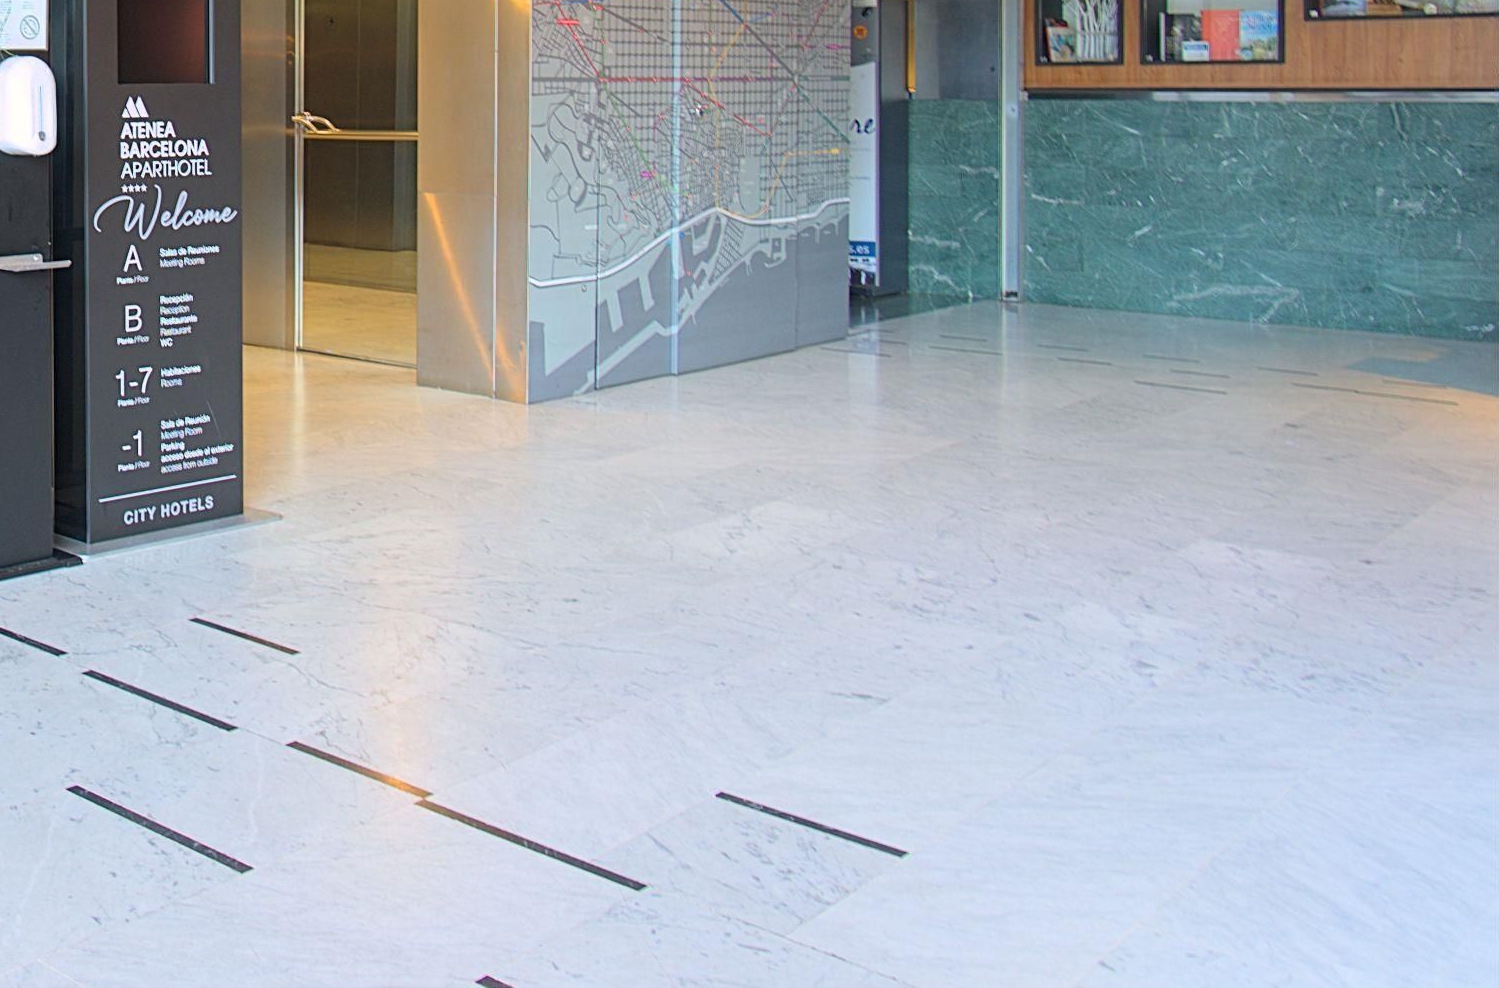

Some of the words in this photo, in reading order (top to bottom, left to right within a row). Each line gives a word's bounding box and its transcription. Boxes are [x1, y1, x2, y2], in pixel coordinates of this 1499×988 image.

[120, 121, 176, 140] ATENEA
[120, 139, 209, 158] BARCELONA
[120, 159, 212, 180] APARTHOTEL
[93, 183, 238, 240] Welcome
[123, 244, 143, 272] A
[178, 246, 187, 256] de
[160, 258, 183, 268] Meeting
[184, 257, 206, 266] Rooms
[124, 304, 143, 333] B
[160, 337, 173, 348] WC
[115, 366, 153, 397] 1-7
[160, 378, 183, 388] Rooms
[176, 418, 184, 427] de
[161, 429, 184, 440] Meeting
[185, 427, 203, 436] Room
[122, 430, 142, 457] -1
[161, 441, 185, 452] Parking
[124, 506, 157, 525] CITY
[160, 496, 214, 518] HOTELS
